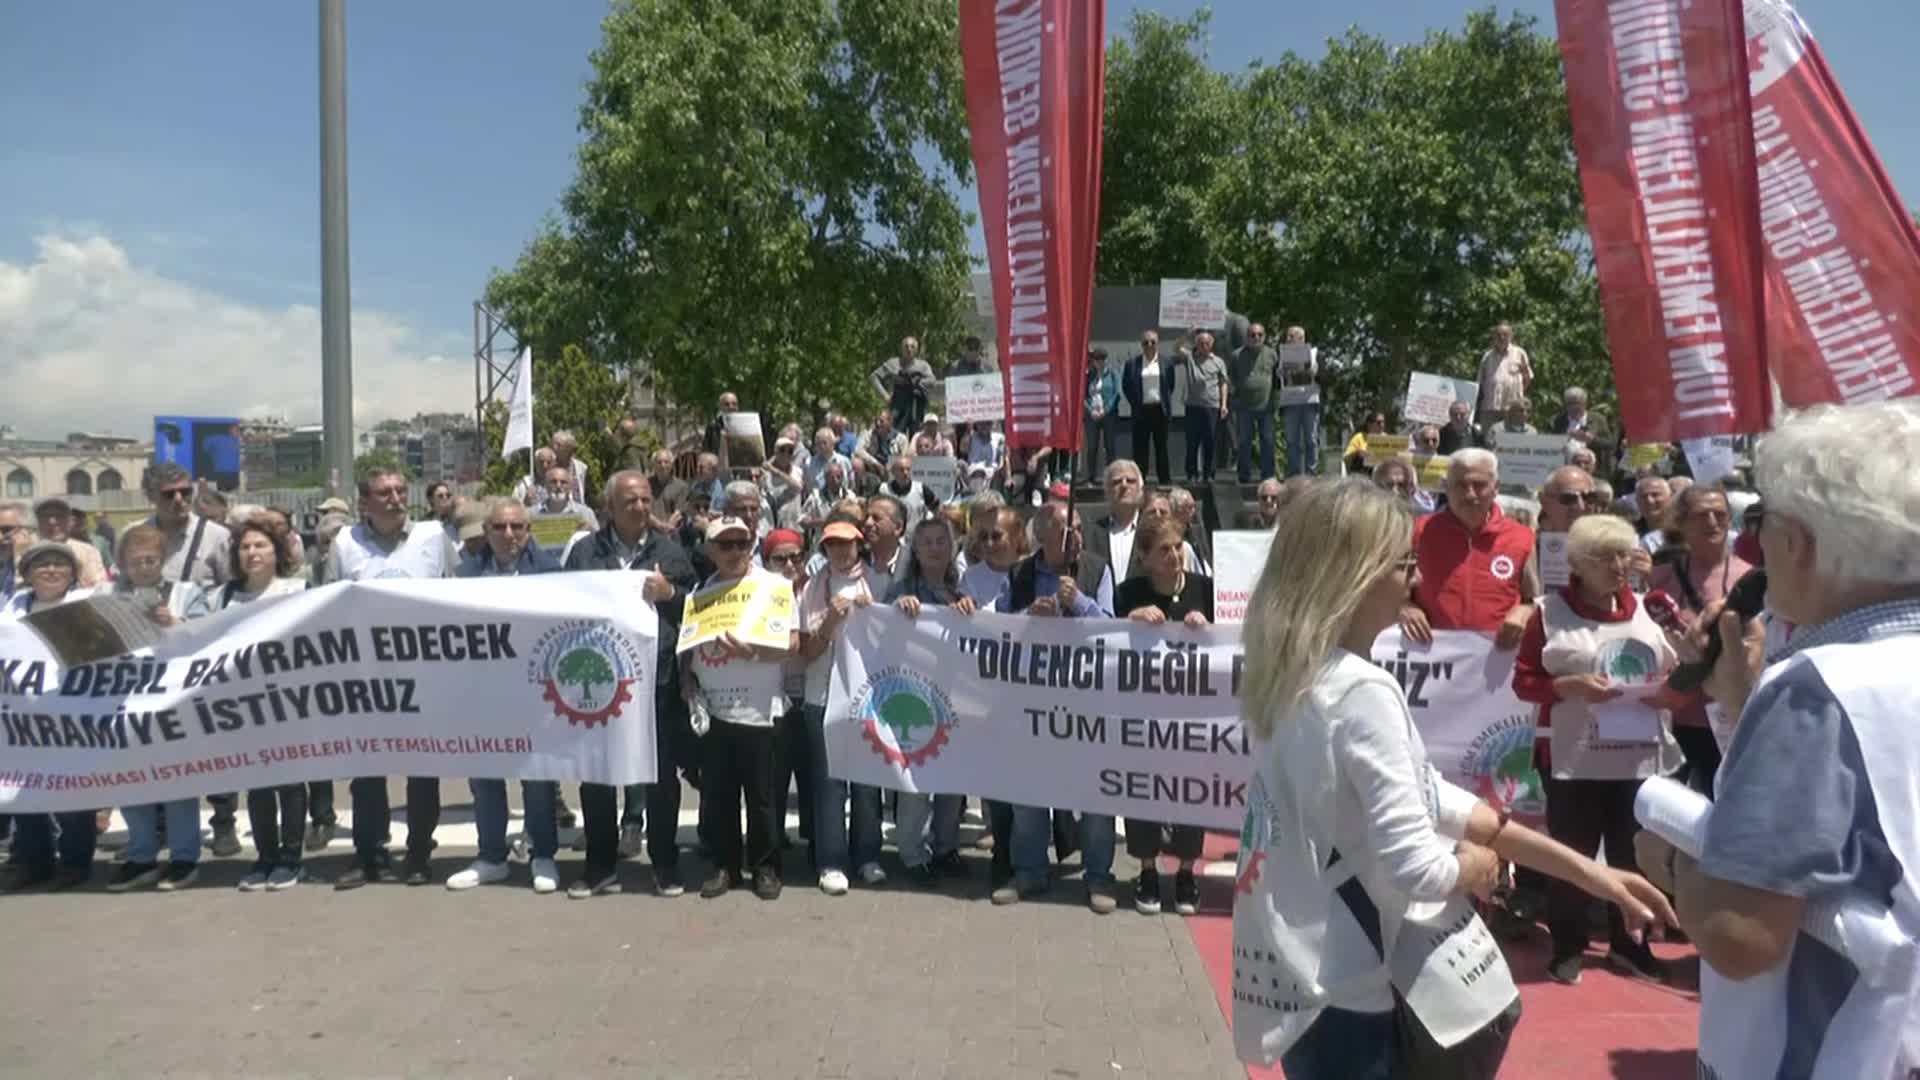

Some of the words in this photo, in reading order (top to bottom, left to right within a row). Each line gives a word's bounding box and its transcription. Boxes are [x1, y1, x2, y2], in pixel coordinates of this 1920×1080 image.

[60, 655, 169, 697] DEĞİL
[182, 627, 361, 690] BAYRAM
[370, 622, 517, 663] EDECEK
[1118, 641, 1218, 697] DEĞİL
[1, 703, 187, 749] İKRAMİYE
[193, 679, 421, 736] İSTİYORUZ
[1023, 704, 1107, 744] TÜM
[46, 769, 147, 791] SENDİKASI
[151, 751, 256, 782] İSTANBUL
[257, 735, 352, 767] ŞUBELERİ
[356, 739, 381, 754] VE
